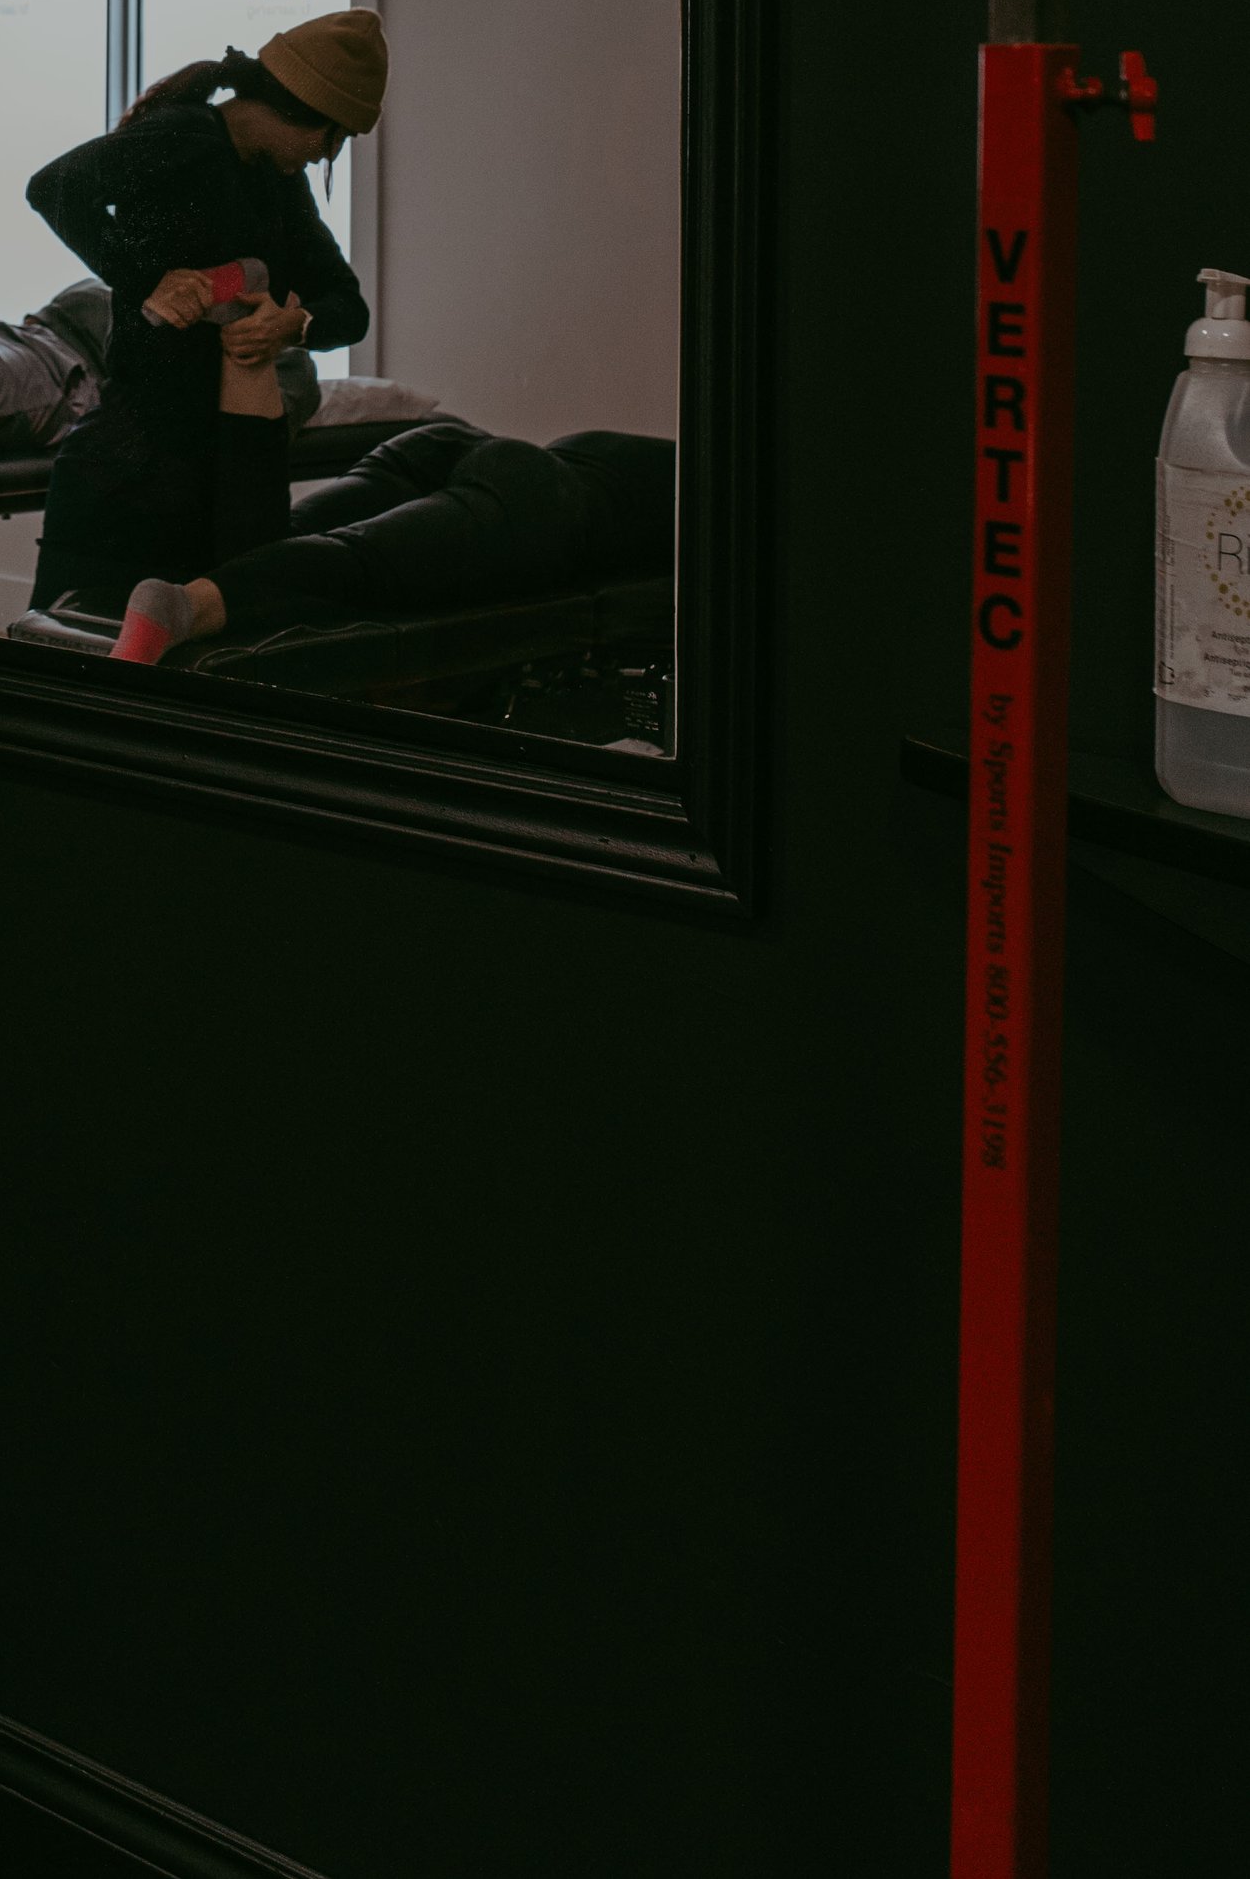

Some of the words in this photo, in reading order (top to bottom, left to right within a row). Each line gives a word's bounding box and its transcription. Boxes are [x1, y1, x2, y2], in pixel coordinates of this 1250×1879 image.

[978, 229, 1028, 651] VERTEC
[983, 740, 1016, 831] Sports
[980, 841, 1013, 955] Imports
